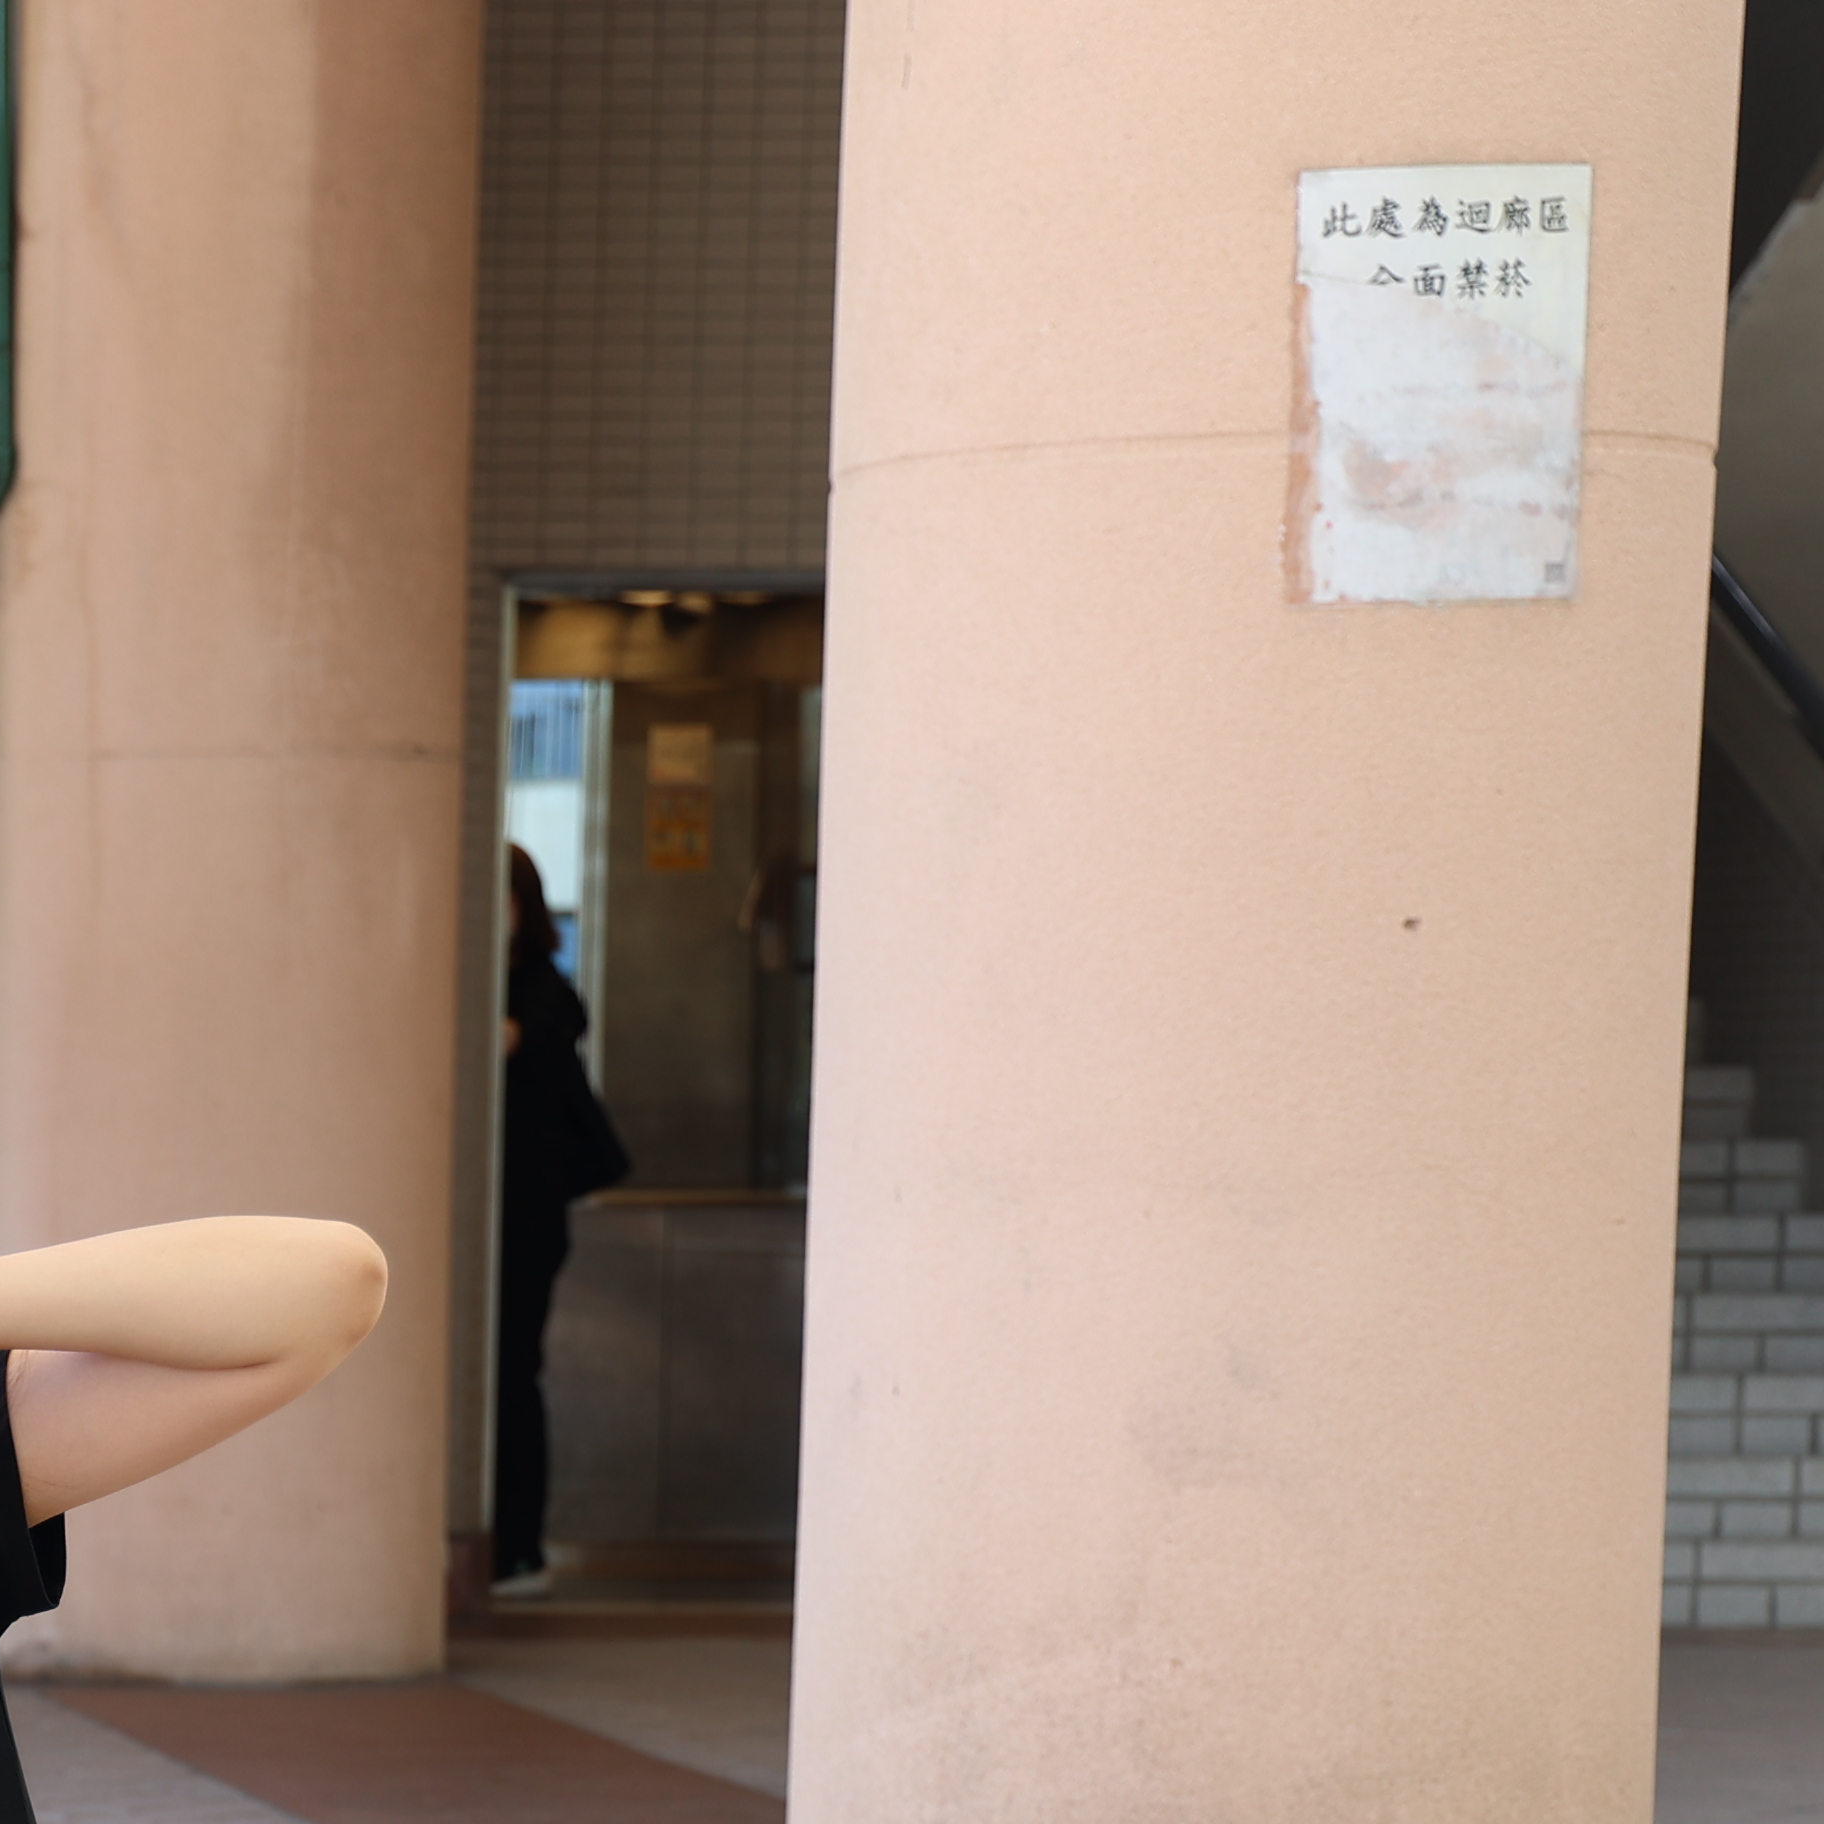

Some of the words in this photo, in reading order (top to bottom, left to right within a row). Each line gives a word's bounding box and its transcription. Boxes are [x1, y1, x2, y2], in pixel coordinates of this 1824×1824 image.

[1321, 194, 1571, 240] 此處為迴廊區
